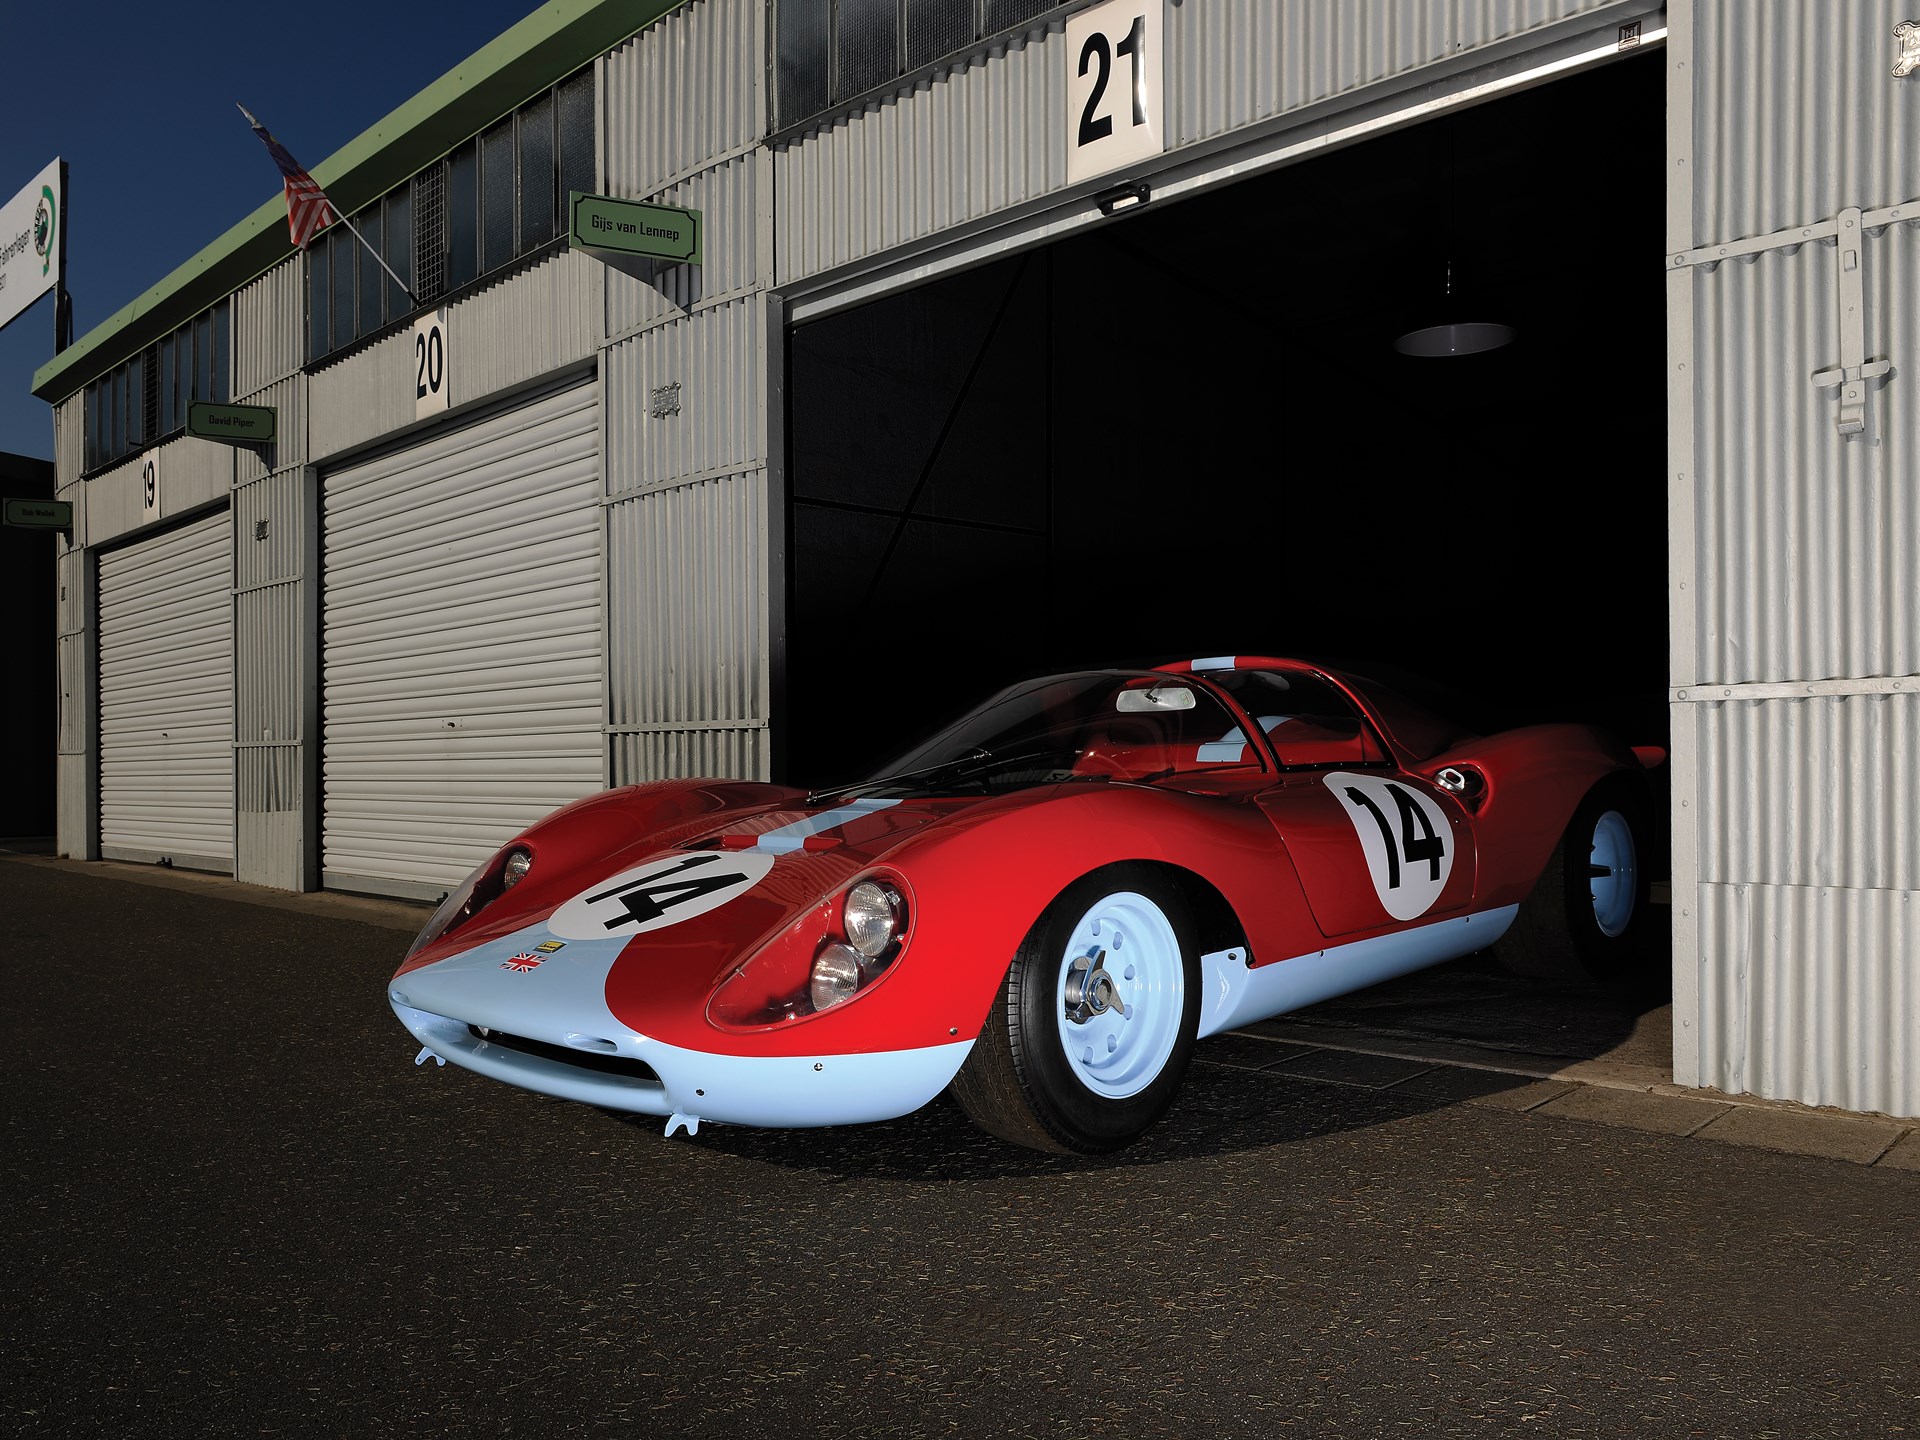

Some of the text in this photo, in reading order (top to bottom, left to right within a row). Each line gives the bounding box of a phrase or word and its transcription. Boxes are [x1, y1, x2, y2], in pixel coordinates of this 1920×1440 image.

[1078, 14, 1147, 148] 21
[592, 214, 680, 242] Gijs van Lennep
[416, 326, 443, 400] 20
[209, 414, 255, 428] David Piper
[143, 460, 155, 509] 19
[1344, 785, 1445, 889] 14
[585, 854, 749, 931] 14
